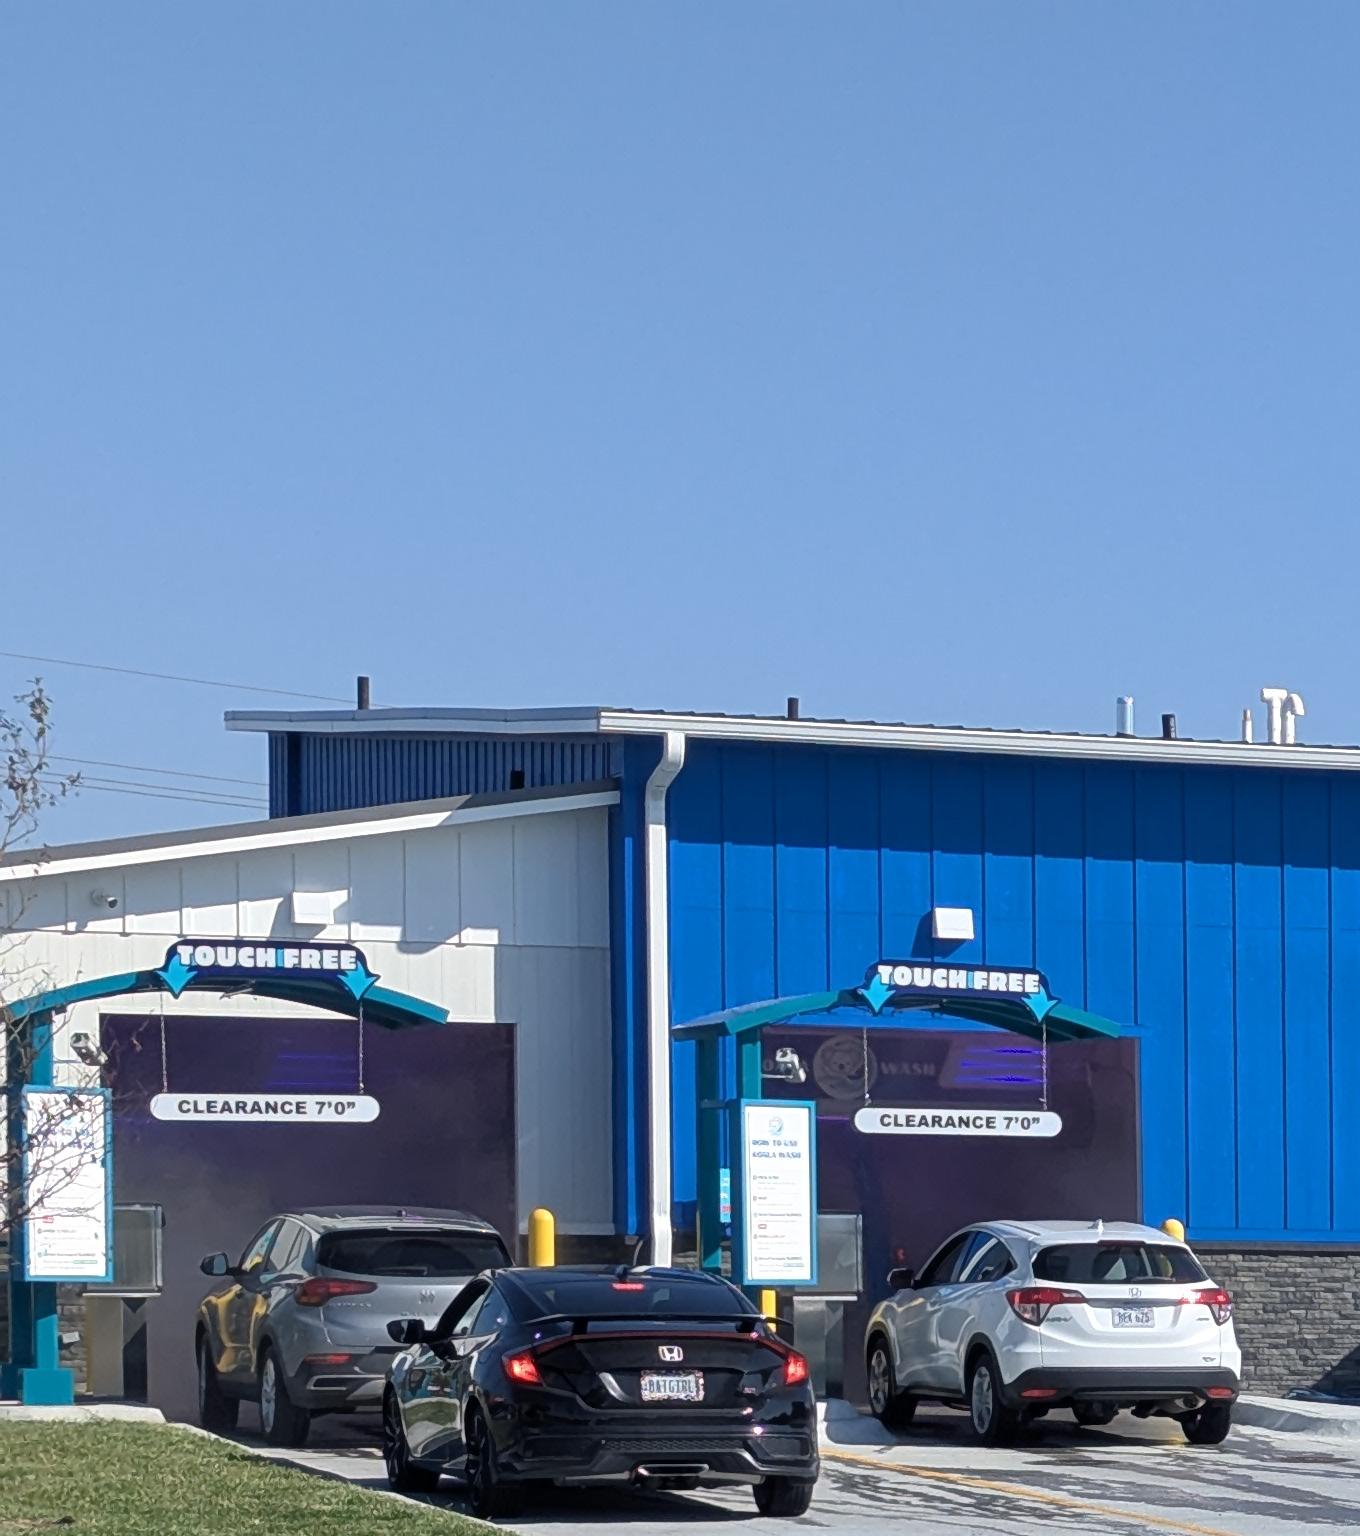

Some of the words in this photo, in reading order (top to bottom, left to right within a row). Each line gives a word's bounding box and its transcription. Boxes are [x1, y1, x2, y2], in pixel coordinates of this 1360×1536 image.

[177, 945, 276, 968] TOUCH
[284, 949, 357, 970] FREE
[877, 965, 967, 989] TOUCH
[973, 972, 1040, 993] FREE
[880, 1061, 936, 1076] WASH
[178, 1100, 307, 1115] CLEARANCE
[880, 1113, 997, 1130] CLEARANCE
[648, 1379, 694, 1393] BATGIRL
